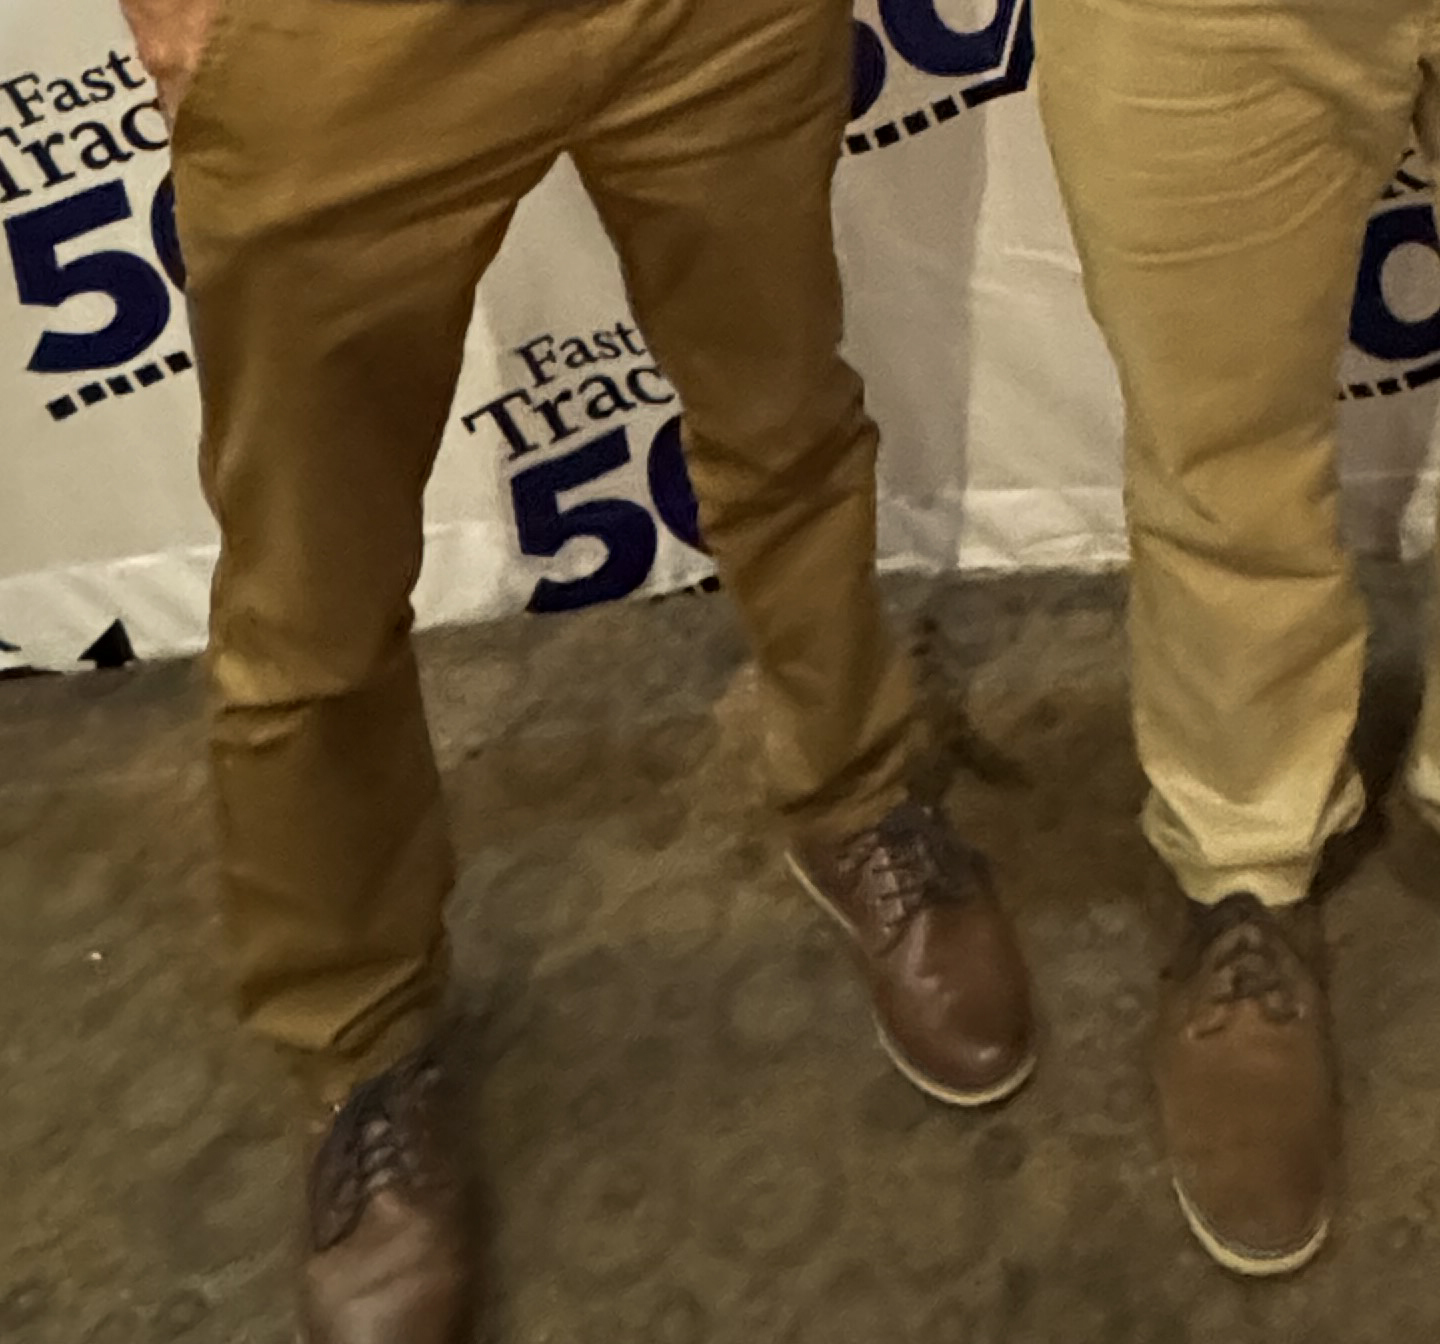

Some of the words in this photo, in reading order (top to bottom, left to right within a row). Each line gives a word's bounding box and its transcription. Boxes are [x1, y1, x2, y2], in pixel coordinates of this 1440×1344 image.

[0, 50, 146, 128] Fast
[514, 321, 647, 388] Fast
[461, 367, 677, 461] Trac
